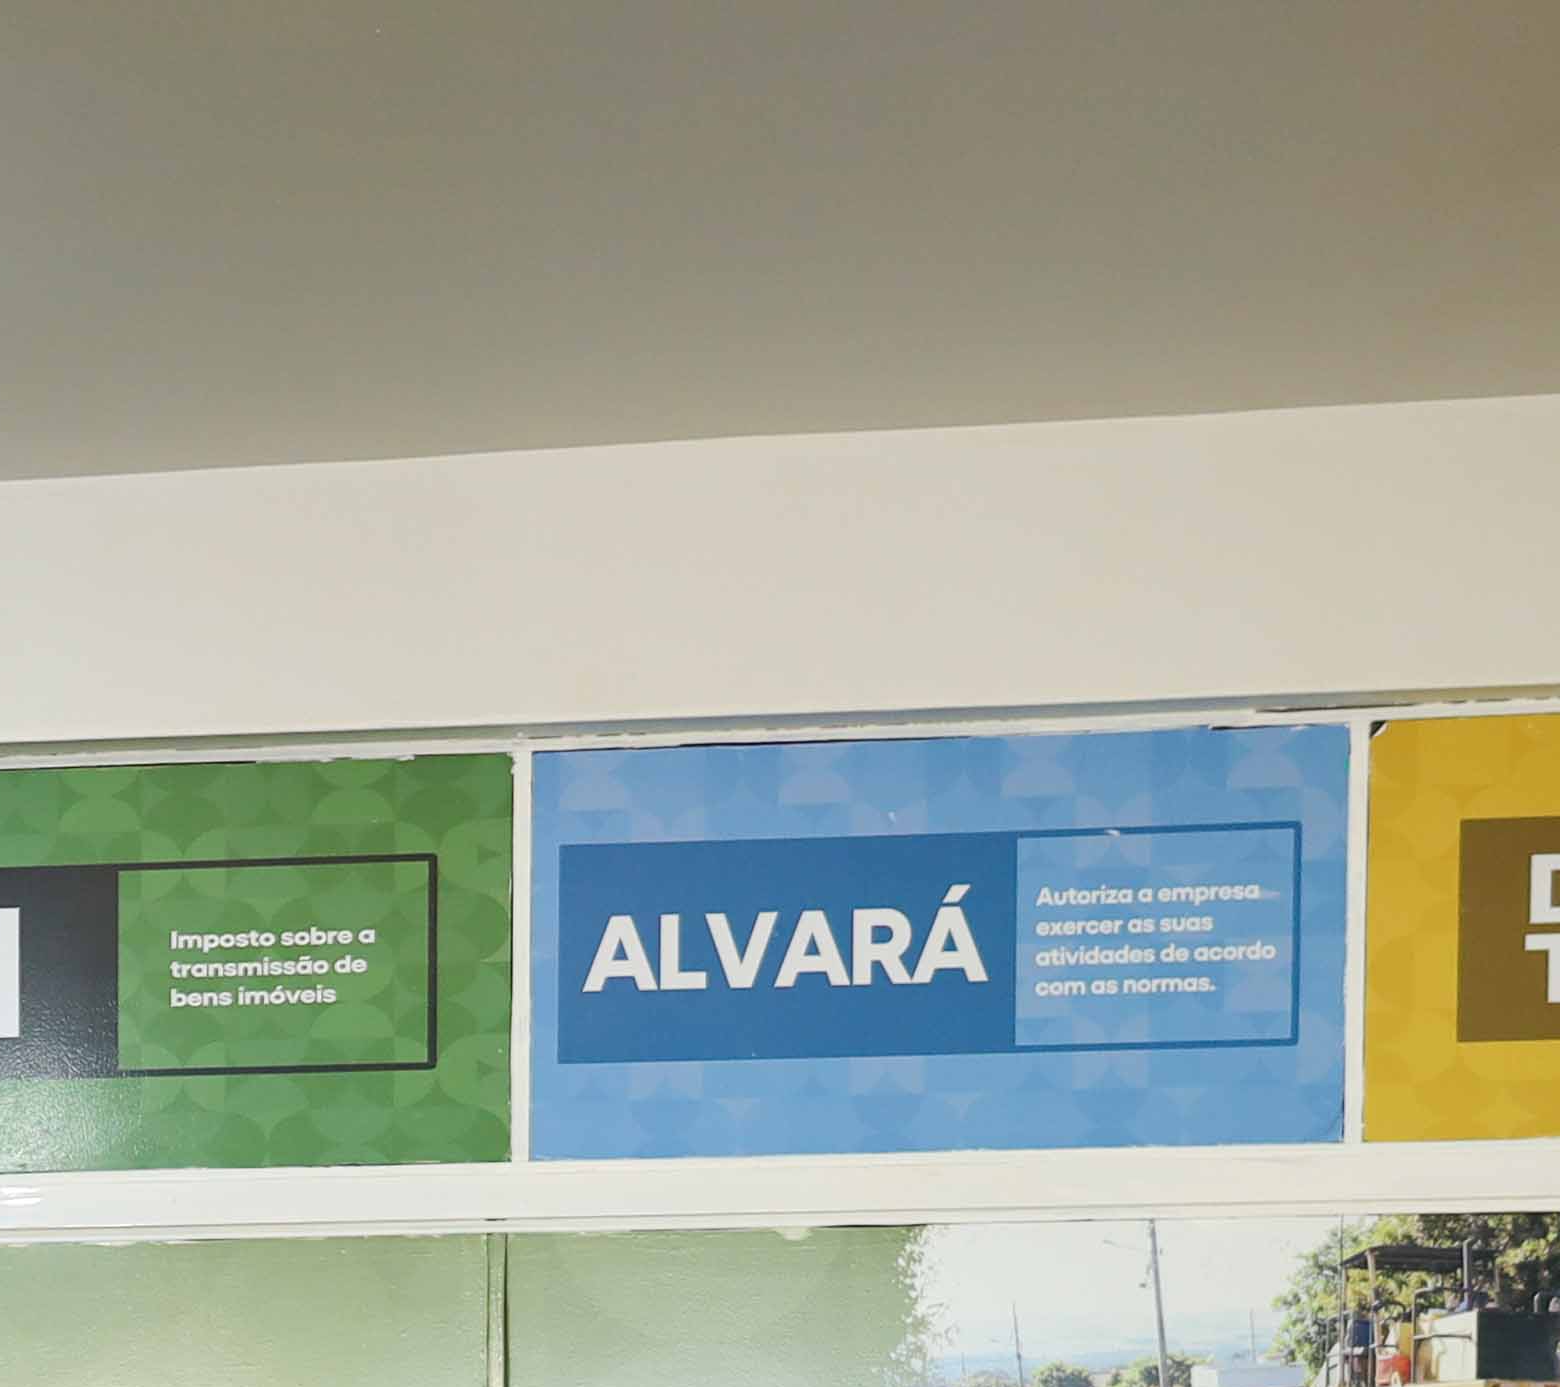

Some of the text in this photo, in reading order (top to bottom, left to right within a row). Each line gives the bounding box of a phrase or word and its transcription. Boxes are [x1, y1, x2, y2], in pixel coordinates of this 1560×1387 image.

[1036, 882, 1261, 907] Autoriza a empresa
[1036, 915, 1213, 936] exercer as suas
[170, 927, 375, 953] Imposto sobre a
[581, 884, 989, 994] ALVARÁ
[1035, 940, 1277, 967] atividades de acordo
[170, 955, 368, 977] transmissão de
[170, 984, 336, 1008] bens imóveis
[1035, 975, 1216, 996] com as normas.
